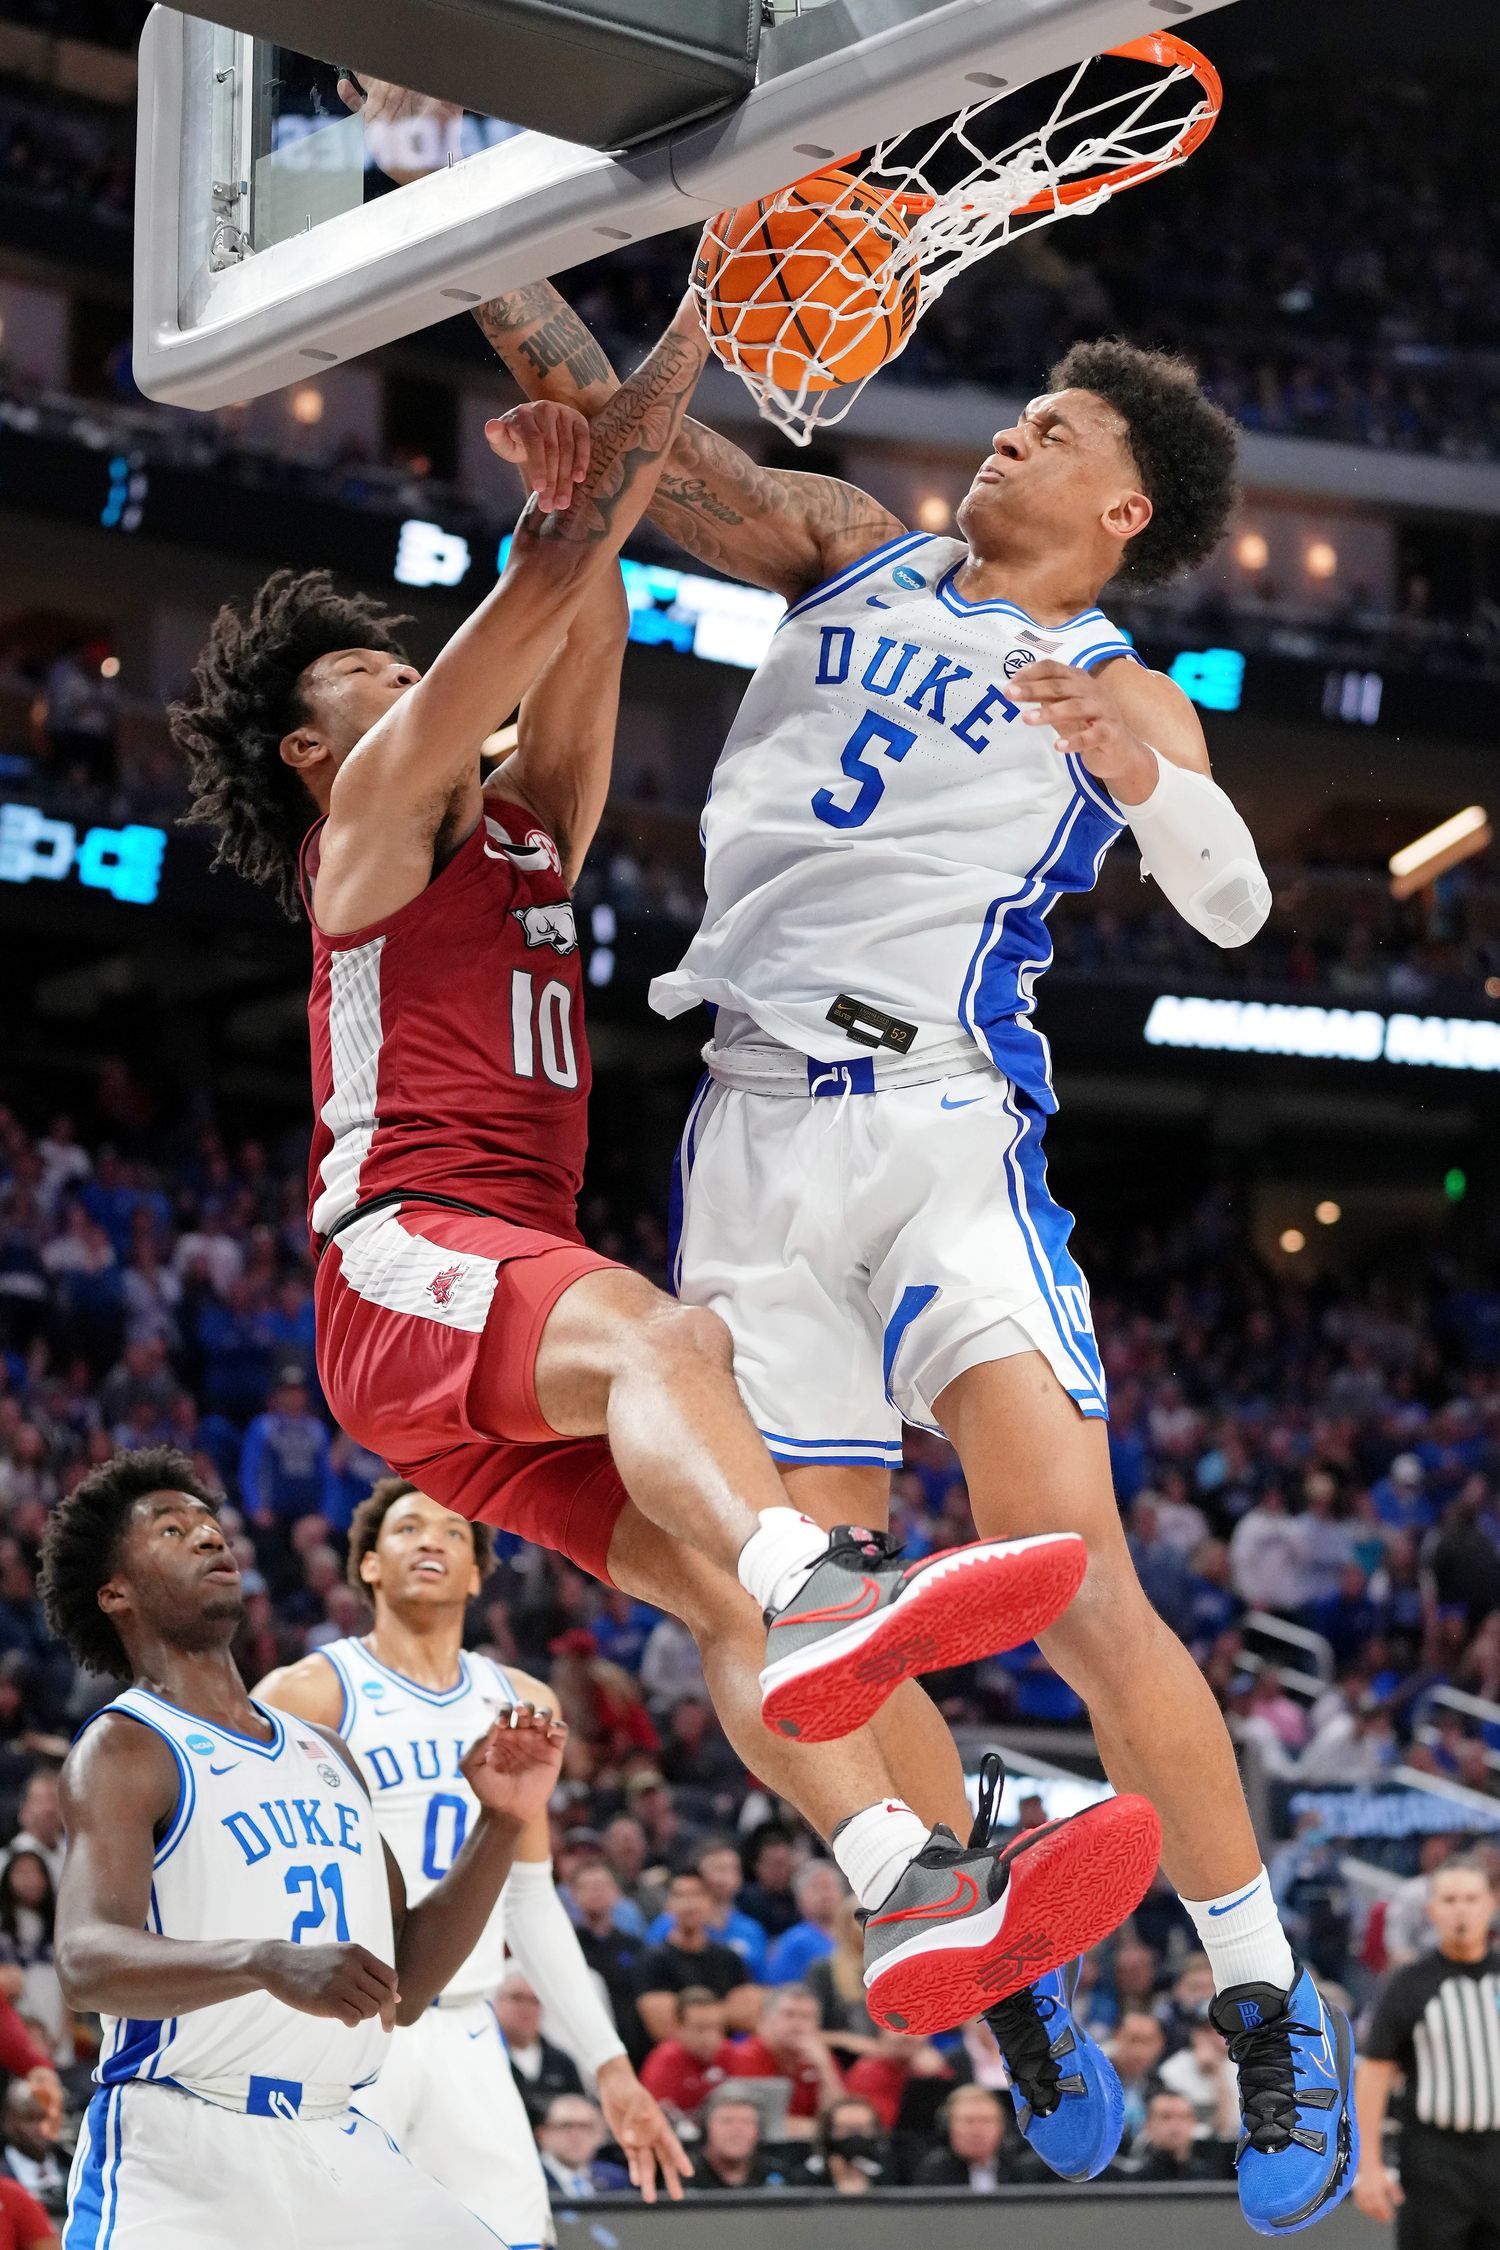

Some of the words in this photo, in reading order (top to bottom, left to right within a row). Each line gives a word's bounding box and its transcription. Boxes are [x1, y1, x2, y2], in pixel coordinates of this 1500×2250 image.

[815, 626, 1021, 755] DUKE
[811, 709, 918, 829] 5
[511, 968, 579, 1090] 10
[890, 1027, 907, 1043] 52
[221, 1799, 362, 1866] DUKE
[422, 1792, 468, 1880] 0
[284, 1862, 350, 1944] 21
